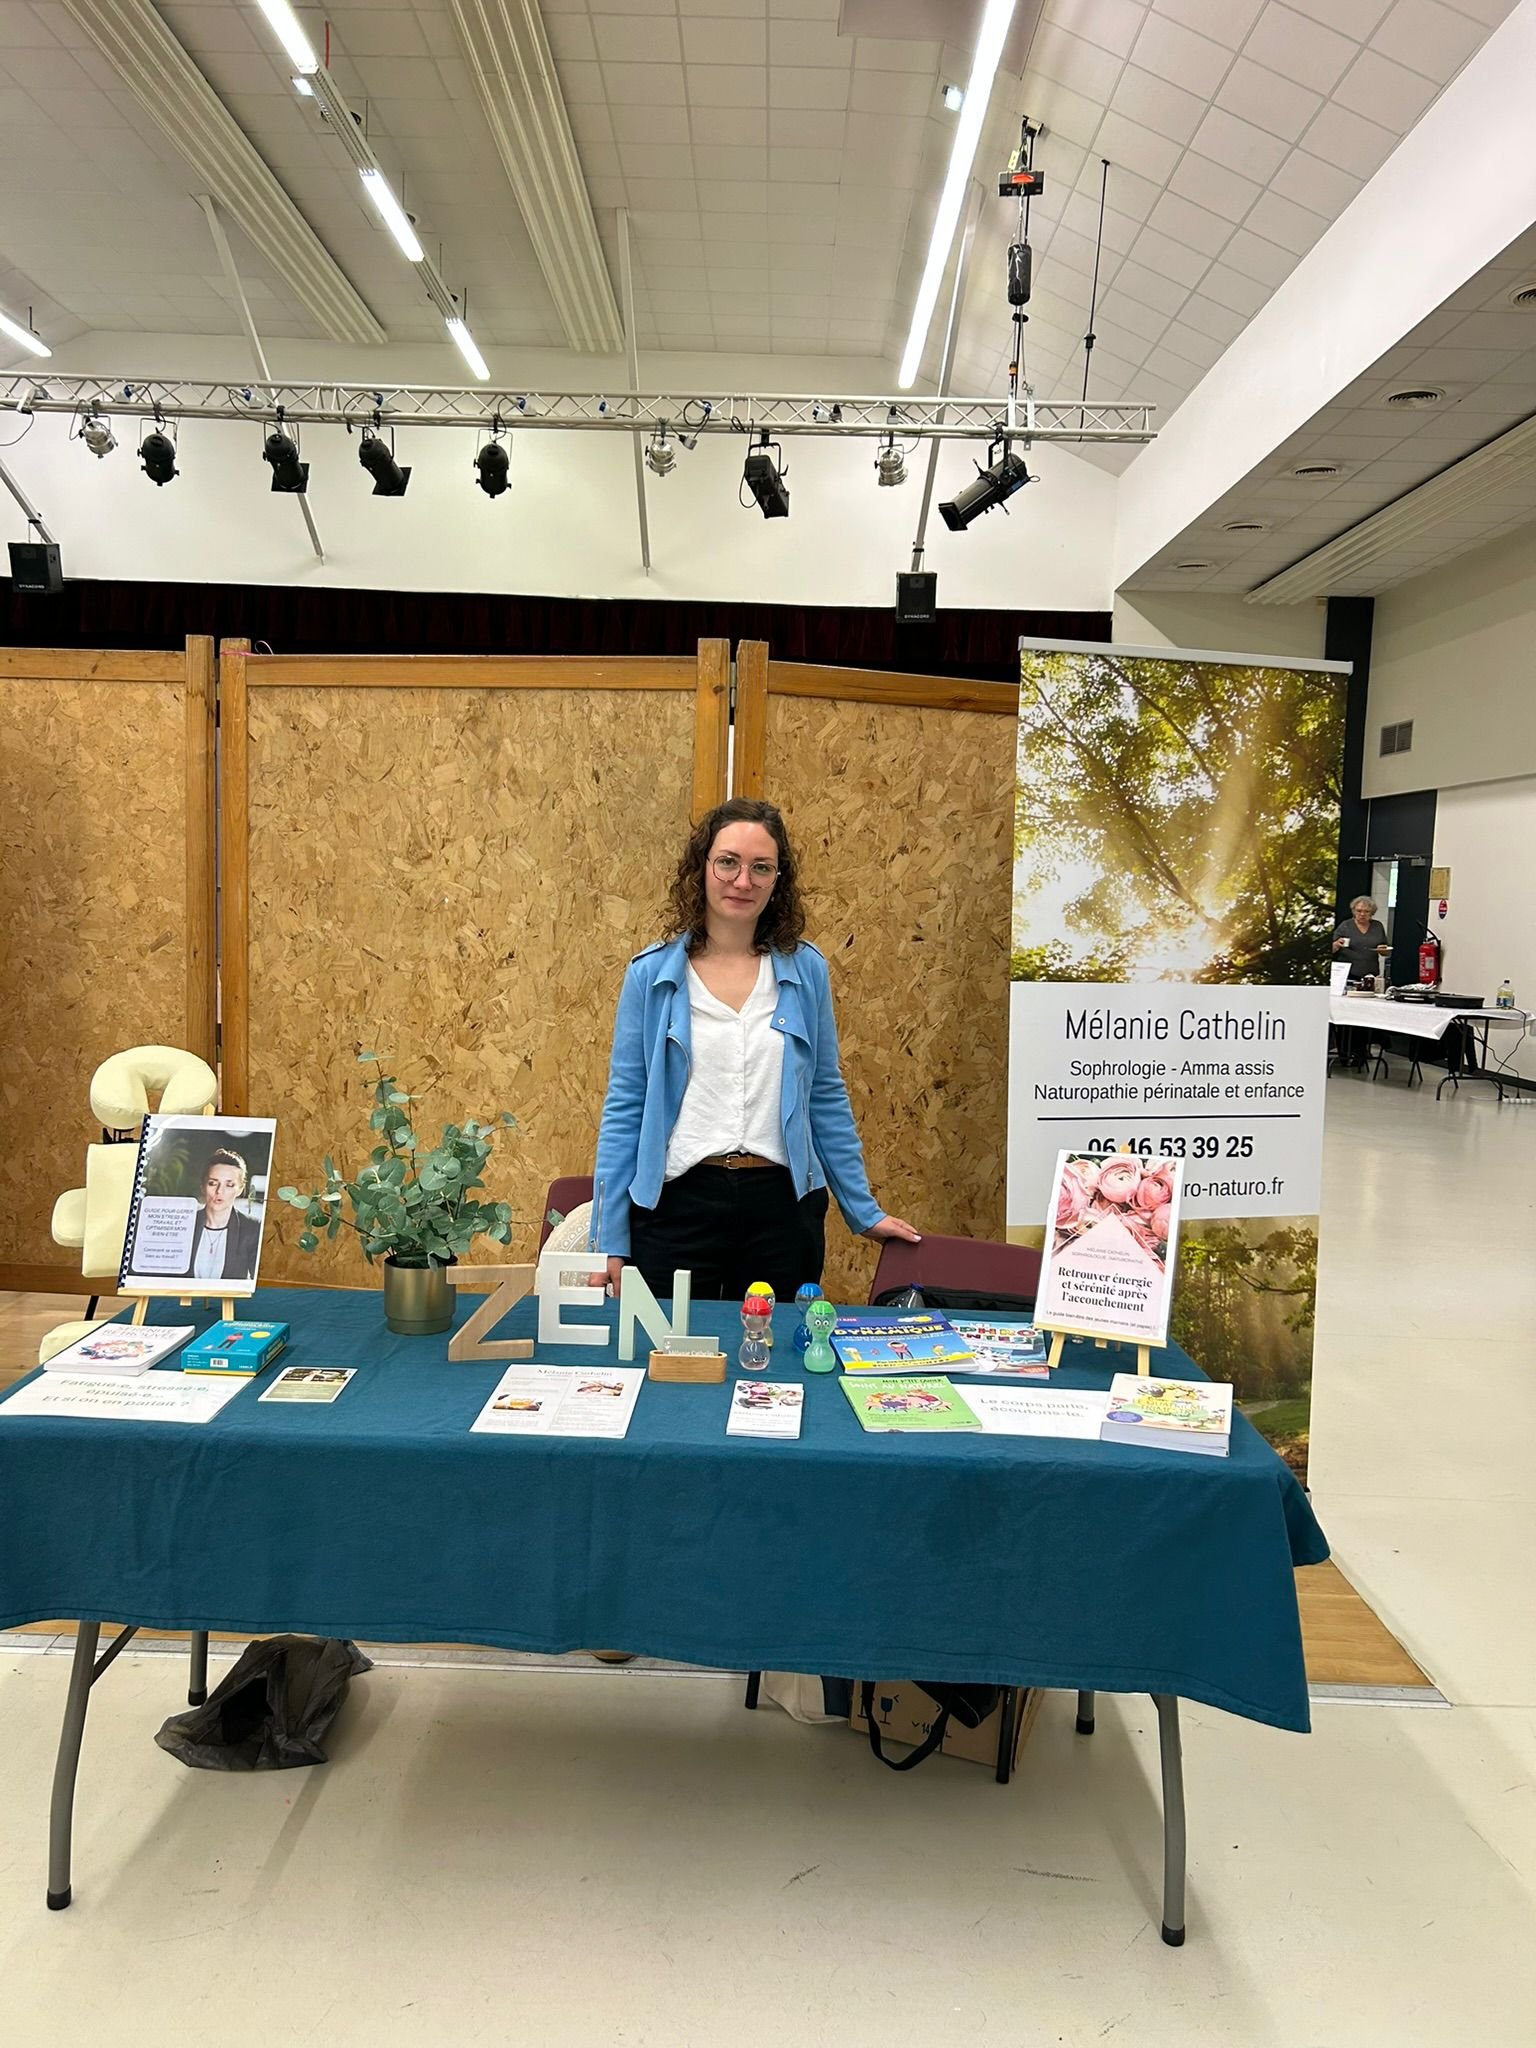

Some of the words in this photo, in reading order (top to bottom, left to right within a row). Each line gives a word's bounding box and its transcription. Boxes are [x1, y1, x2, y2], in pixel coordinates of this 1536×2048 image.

[1065, 1008, 1169, 1040] Mélanie
[1180, 1009, 1286, 1041] Cathelin
[1069, 1060, 1166, 1080] Sophrologie
[1180, 1061, 1231, 1076] Amma
[1235, 1061, 1275, 1076] assis
[1033, 1083, 1138, 1103] Naturopathie
[1144, 1082, 1220, 1103] périnatale
[1225, 1085, 1240, 1098] et
[1244, 1082, 1305, 1098] enfance
[1088, 1137, 1117, 1152] 06
[1159, 1136, 1187, 1158] 53
[1192, 1136, 1219, 1159] 39
[1226, 1135, 1254, 1158] 25
[1183, 1177, 1284, 1197] ro-naturo.fr
[1058, 1266, 1110, 1282] Retrouver
[1112, 1272, 1153, 1289] énergie
[1061, 1280, 1071, 1289] et
[1073, 1280, 1117, 1296] sérénité
[1118, 1287, 1148, 1300] après
[446, 1250, 691, 1361] ZEN
[1062, 1291, 1144, 1312] l'accouchement
[833, 1324, 945, 1337] DYNAMIQUE
[123, 1399, 176, 1407] parlait
[1001, 1399, 1043, 1408] corps
